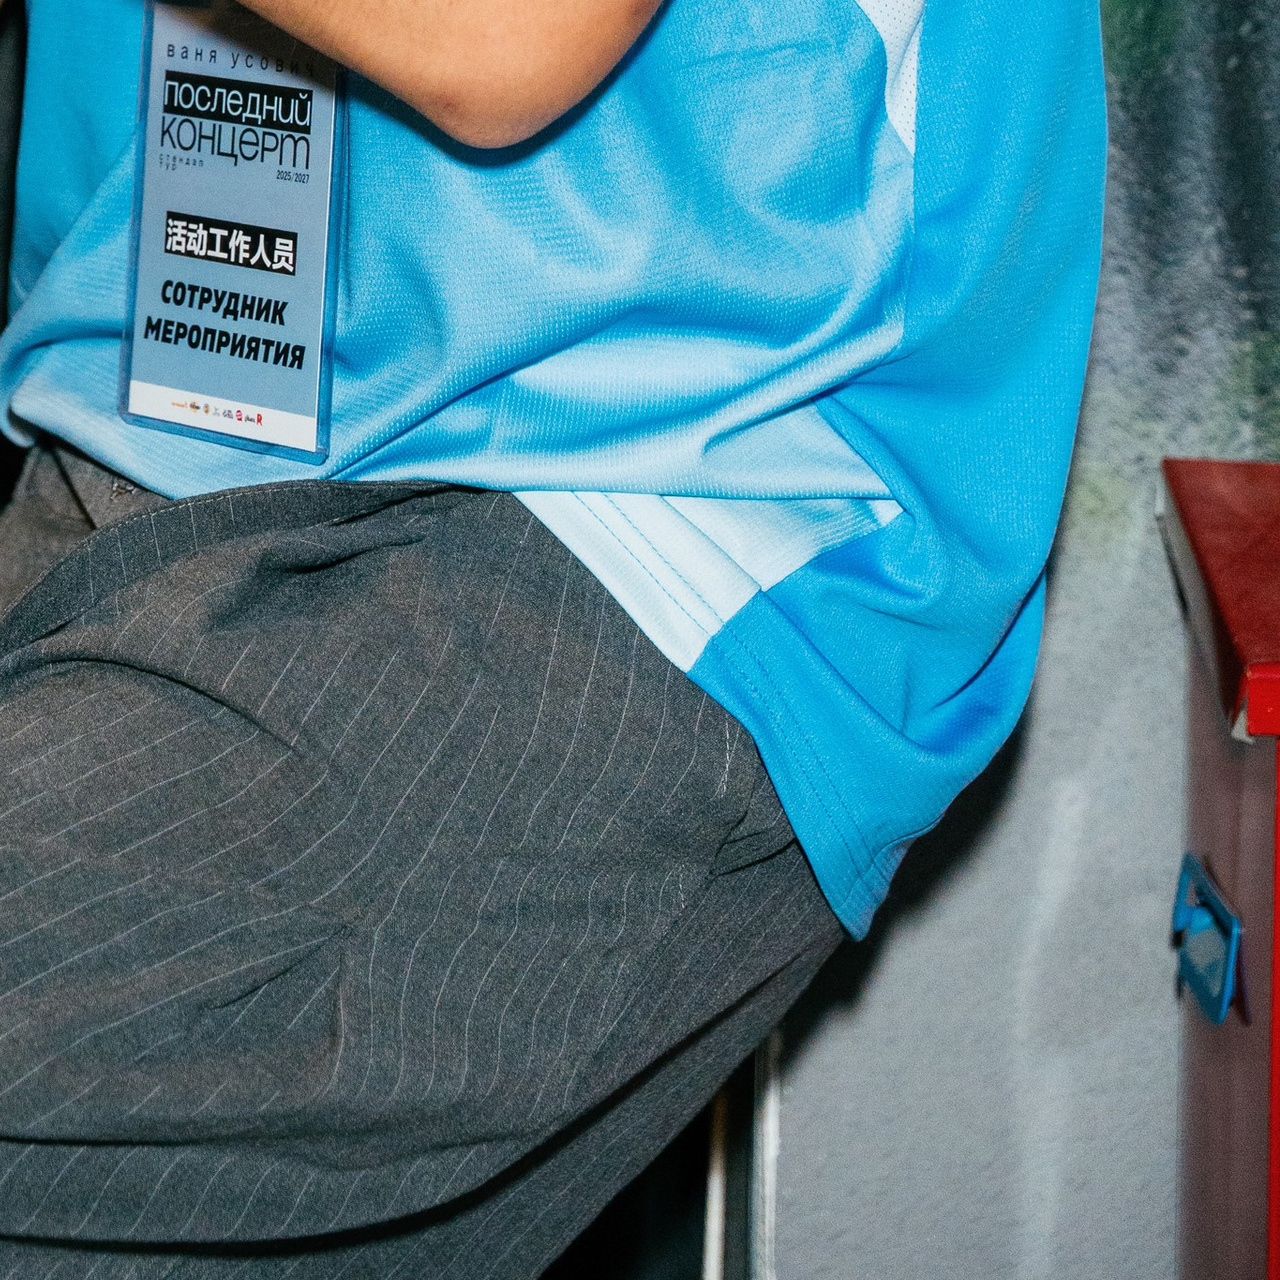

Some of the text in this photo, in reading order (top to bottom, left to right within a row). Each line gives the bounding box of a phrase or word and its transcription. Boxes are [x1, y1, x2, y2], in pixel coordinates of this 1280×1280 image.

[167, 43, 217, 64] ваня
[276, 169, 310, 185] 2025/2027
[166, 218, 295, 273] 活动工作人员
[160, 279, 289, 327] СОТРУДНИК
[143, 315, 307, 371] МЕРОПРИЯТИЯ
